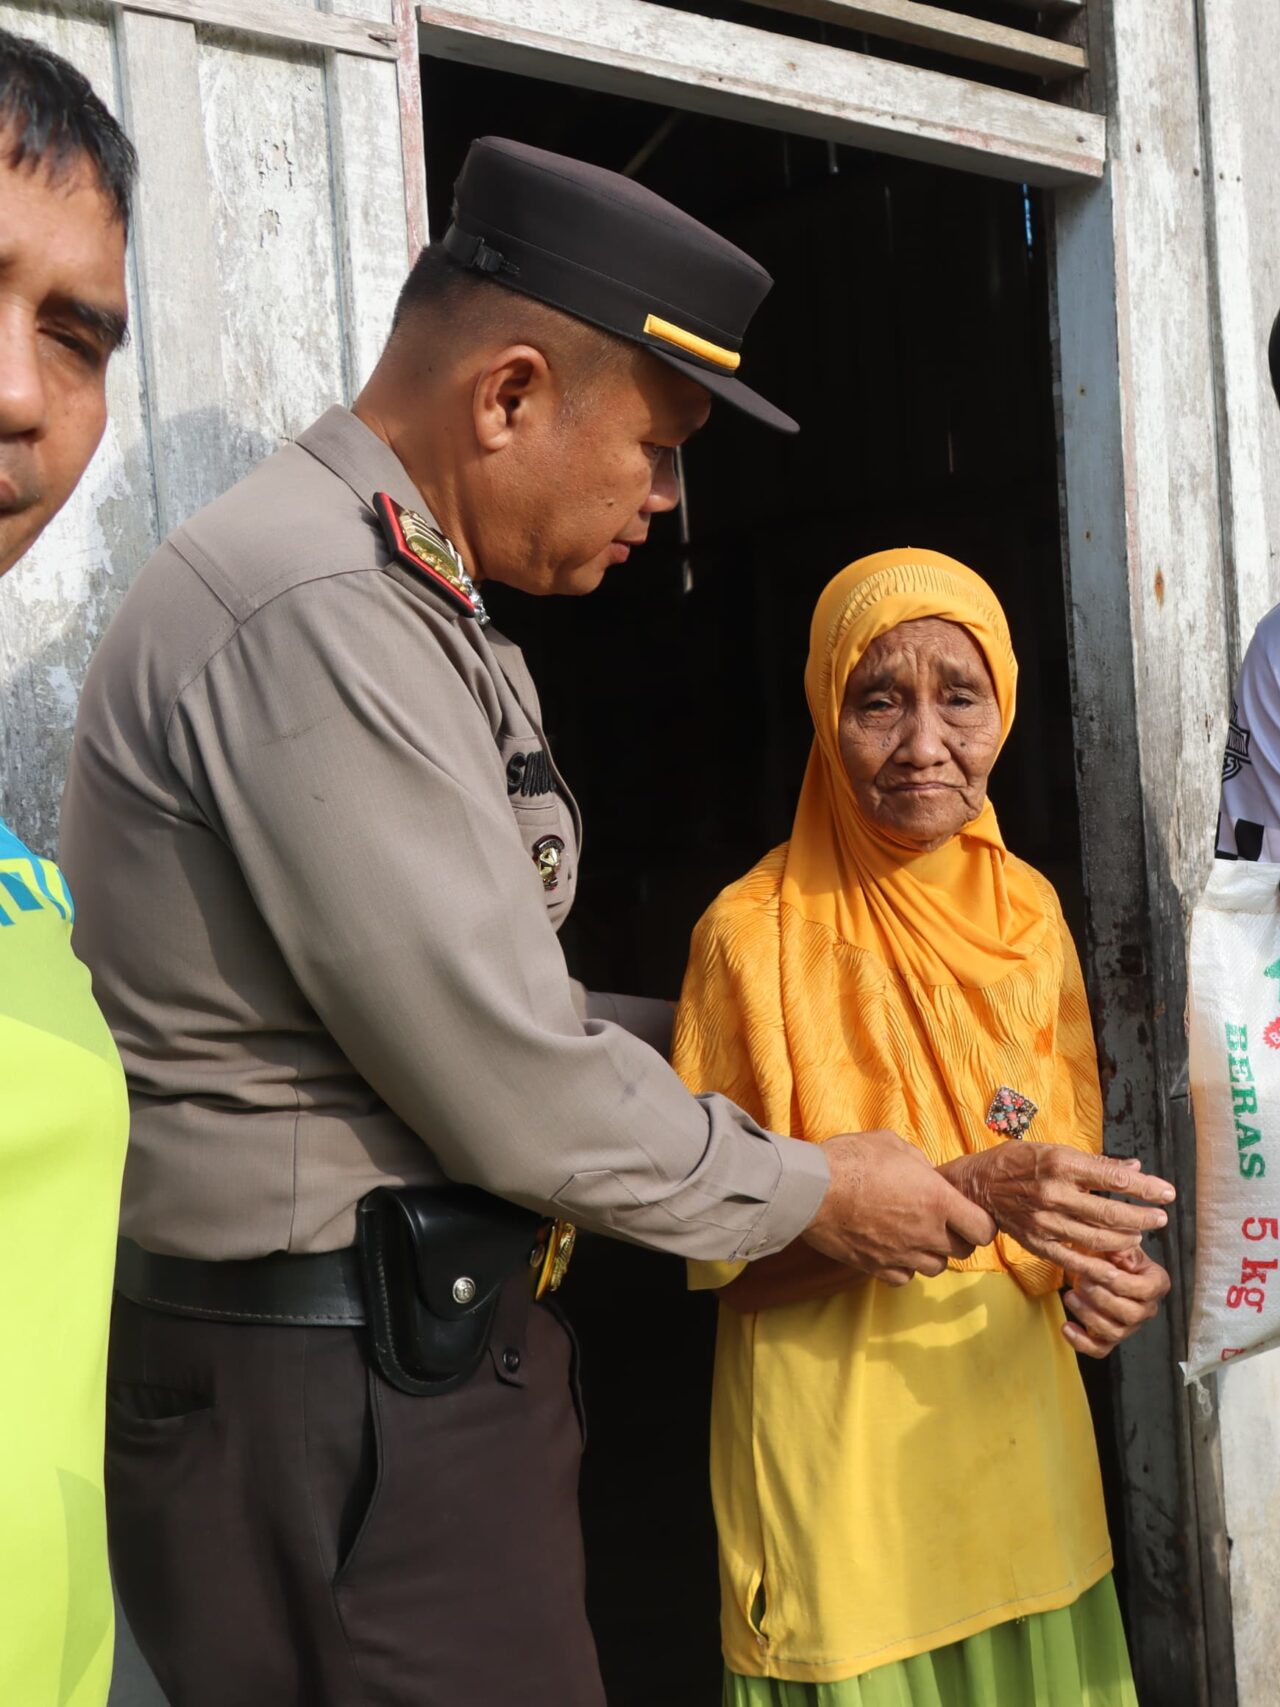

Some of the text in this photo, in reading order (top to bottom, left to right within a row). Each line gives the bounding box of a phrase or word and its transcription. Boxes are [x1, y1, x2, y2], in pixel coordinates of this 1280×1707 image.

[1224, 1022, 1266, 1181] BERAS
[1241, 1216, 1279, 1242] 5
[1225, 1257, 1279, 1314] kg
